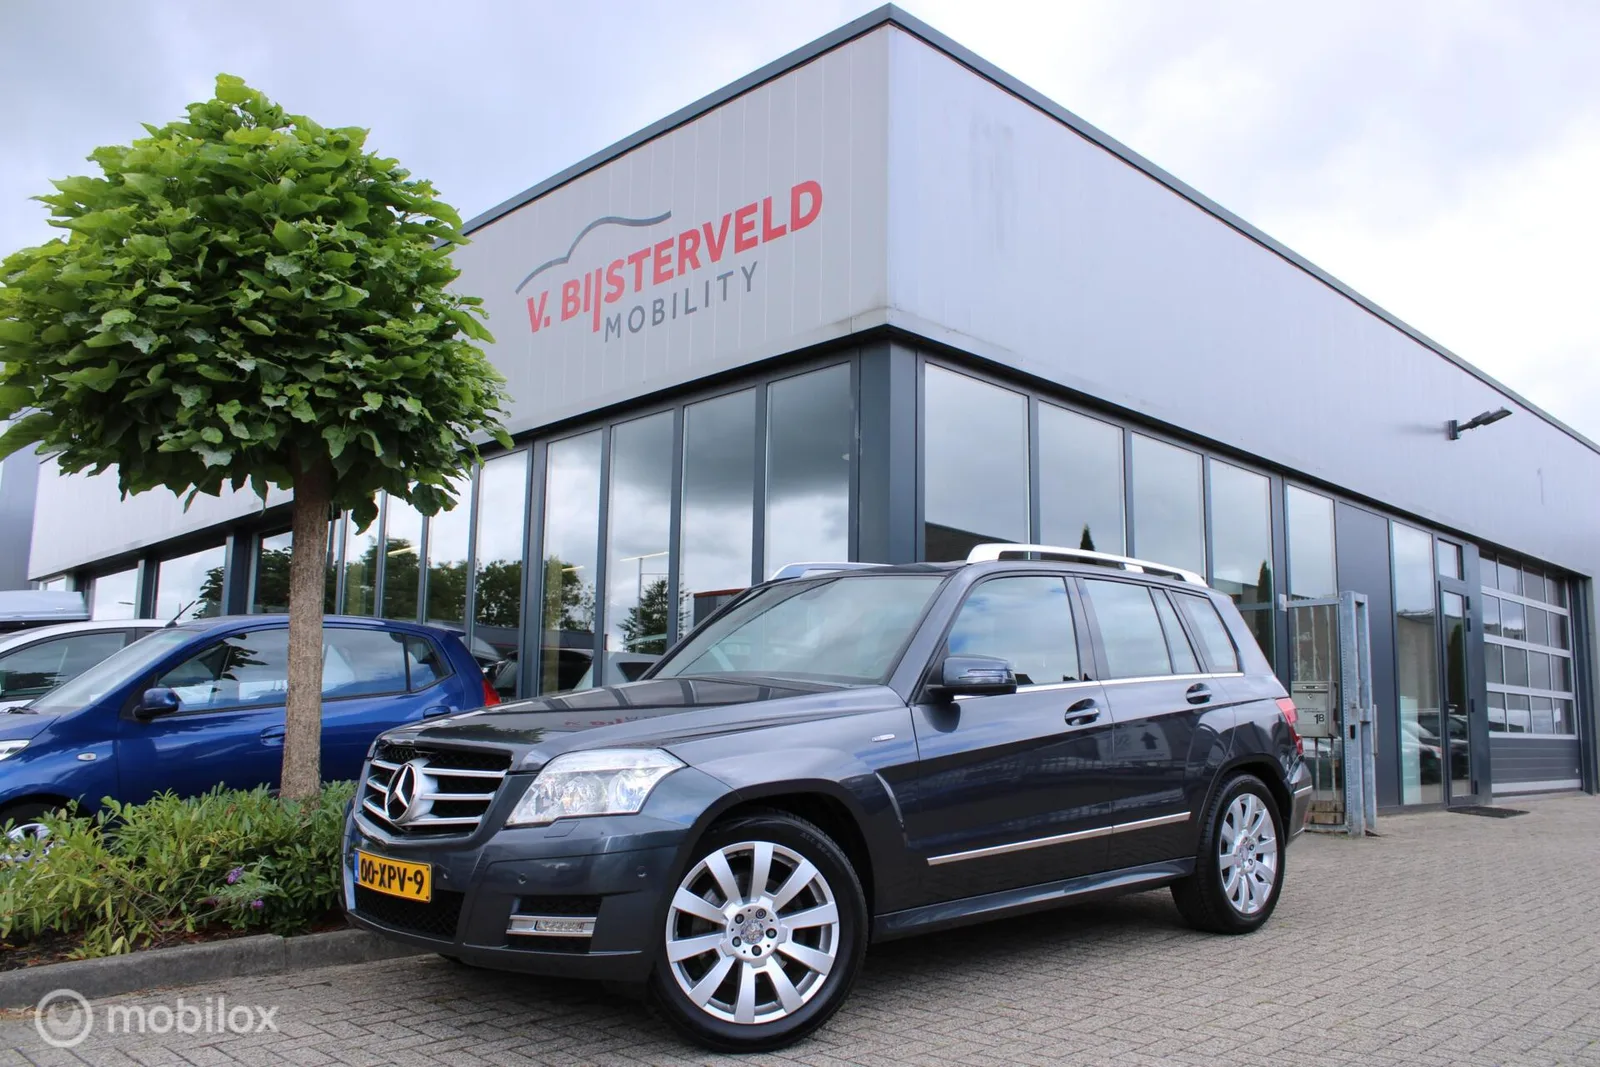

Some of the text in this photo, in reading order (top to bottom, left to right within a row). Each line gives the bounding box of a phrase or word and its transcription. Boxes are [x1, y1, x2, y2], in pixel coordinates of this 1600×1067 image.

[527, 290, 551, 334] V.
[604, 260, 759, 343] MOBILITY
[360, 858, 425, 895] 00-XPV-9
